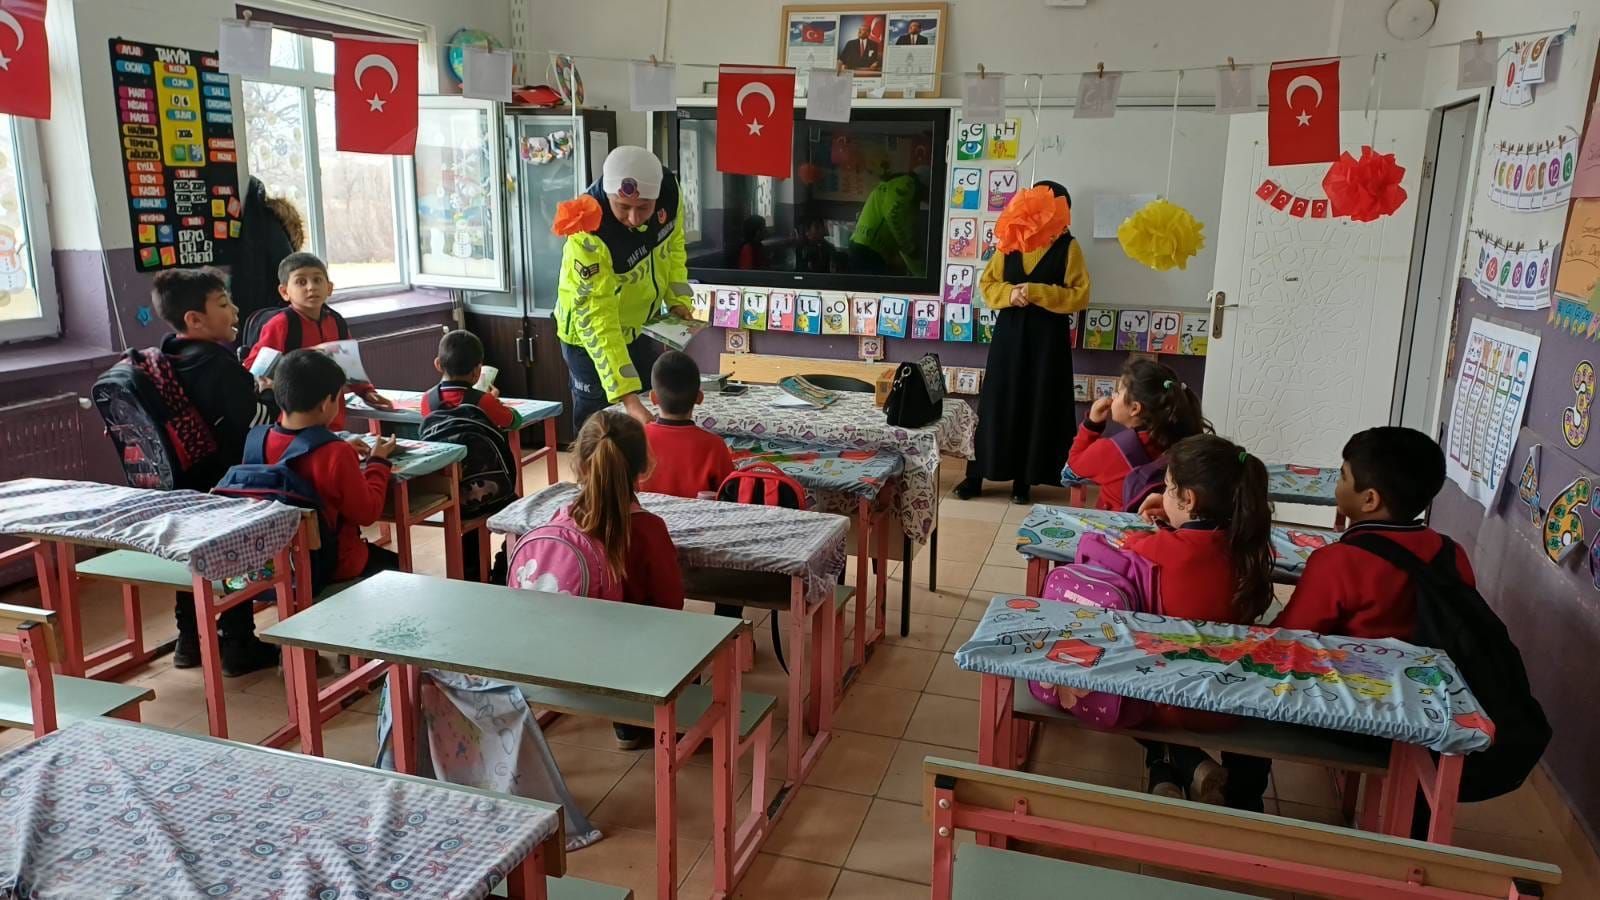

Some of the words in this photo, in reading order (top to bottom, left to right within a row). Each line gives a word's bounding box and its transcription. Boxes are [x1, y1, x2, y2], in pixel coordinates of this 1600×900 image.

[155, 47, 191, 65] TAKVİM
[918, 303, 935, 317] rR
[1124, 315, 1145, 331] yY
[1154, 315, 1176, 331] dD
[1187, 319, 1207, 332] zZ
